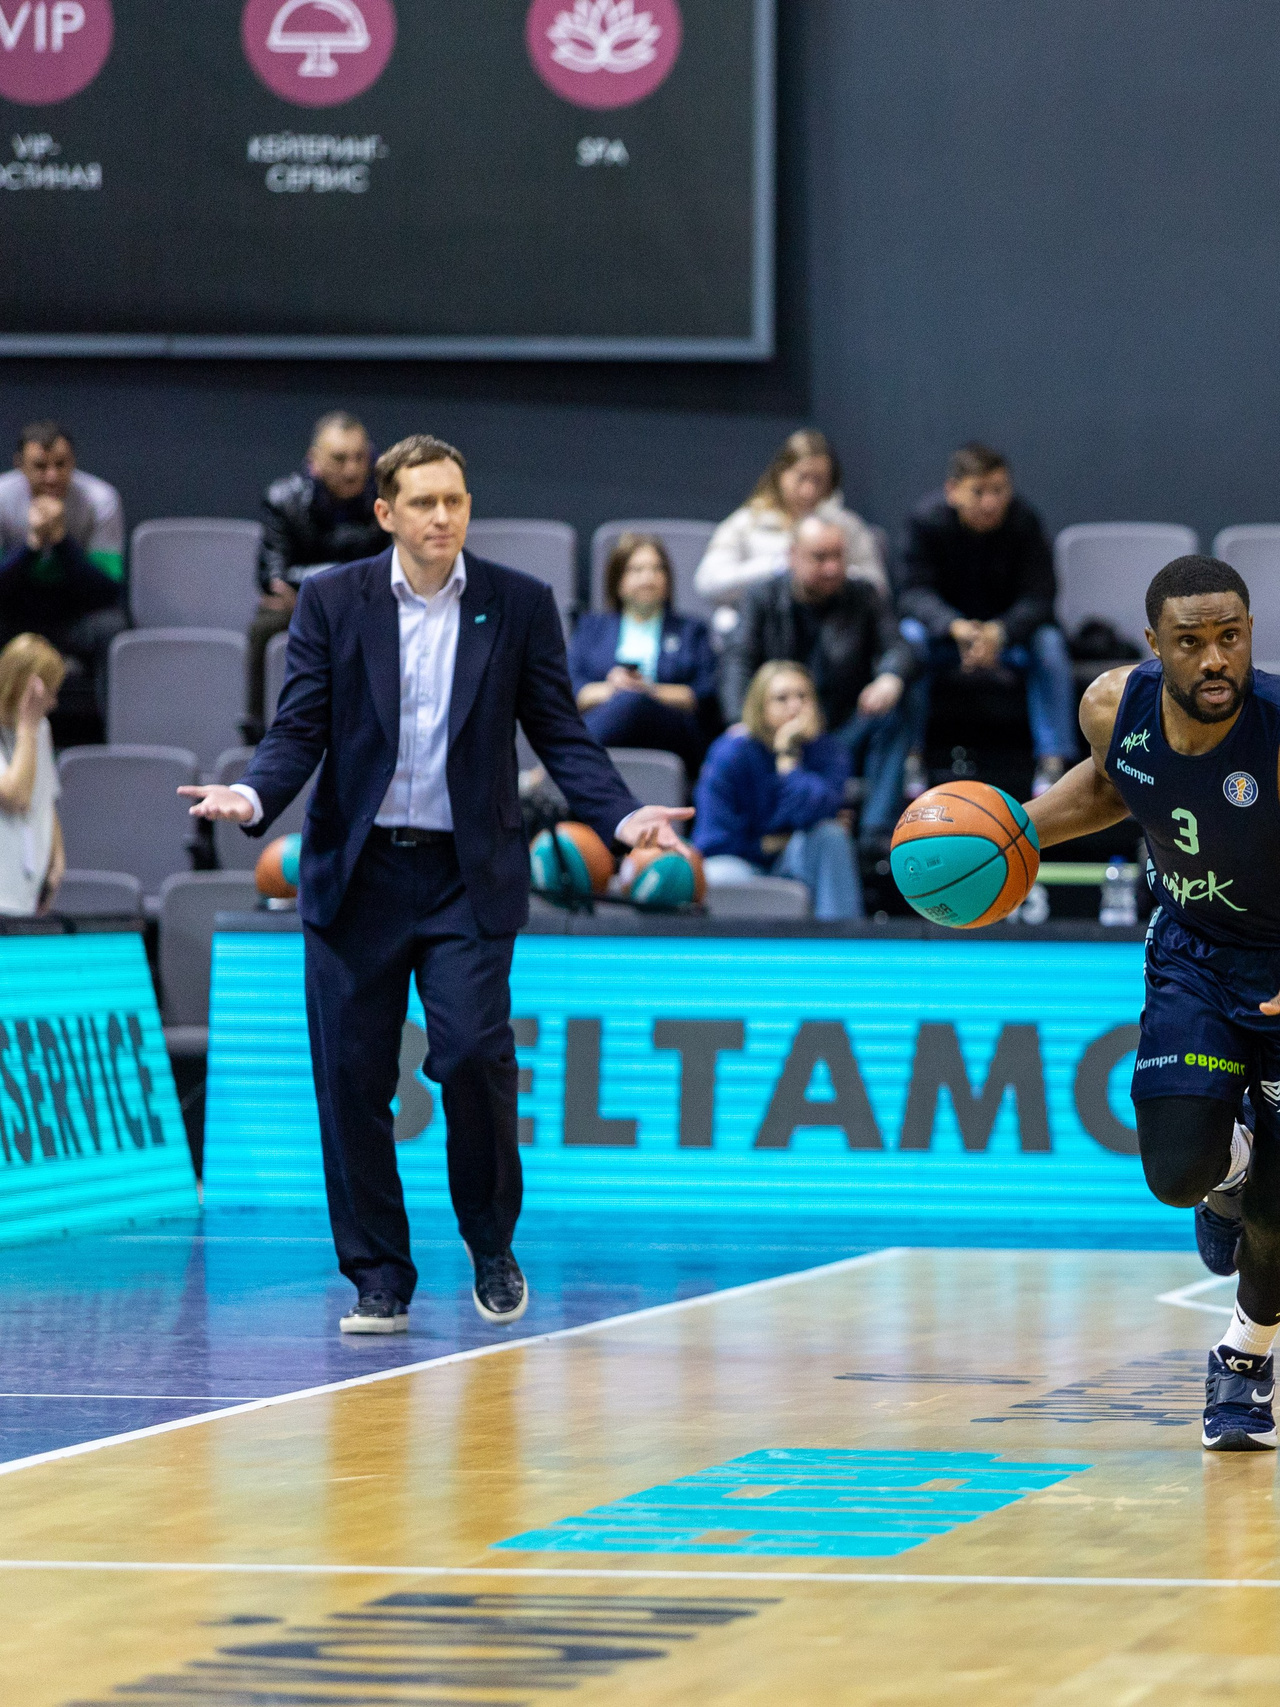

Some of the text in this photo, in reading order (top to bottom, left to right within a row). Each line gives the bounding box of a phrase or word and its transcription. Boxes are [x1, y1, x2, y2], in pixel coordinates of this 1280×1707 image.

[0, 1, 86, 52] VIP
[1116, 757, 1154, 785] Kempa
[1171, 807, 1200, 855] 3
[1136, 1054, 1178, 1071] Kempa
[0, 1010, 166, 1164] SERVICE
